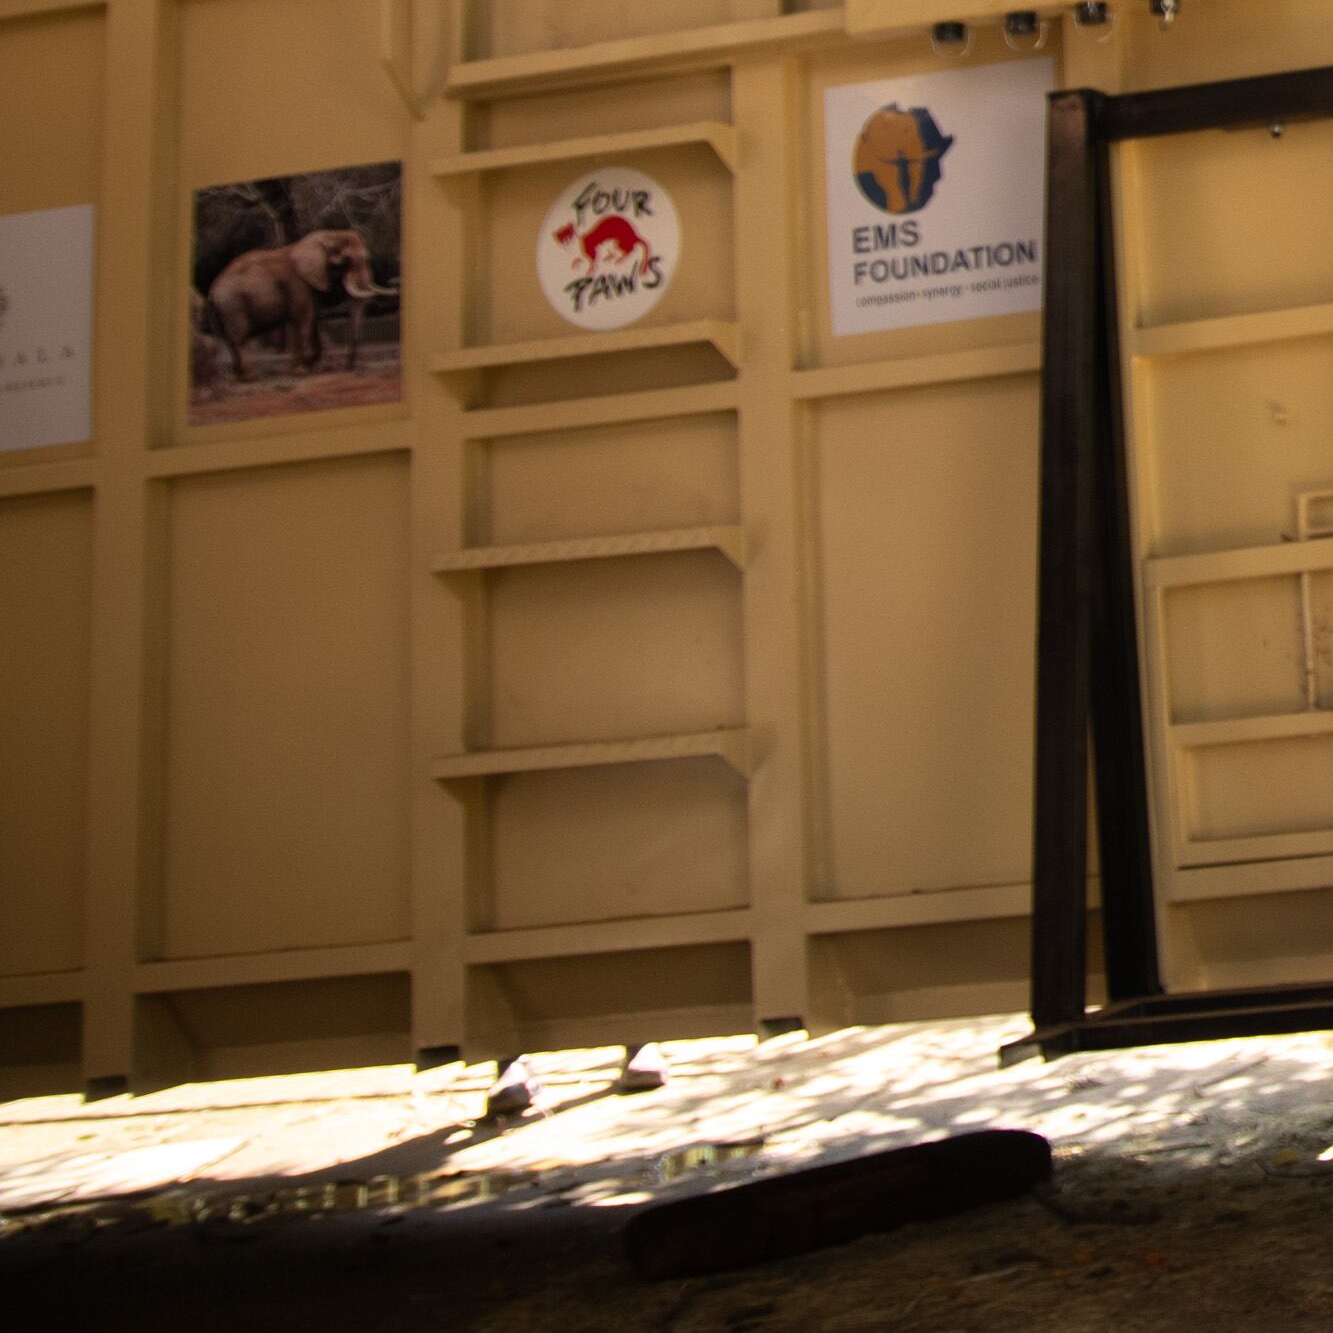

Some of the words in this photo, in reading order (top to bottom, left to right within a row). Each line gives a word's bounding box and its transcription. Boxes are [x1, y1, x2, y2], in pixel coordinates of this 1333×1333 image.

[572, 182, 654, 227] FOUR
[853, 220, 919, 254] EMS
[564, 256, 663, 312] PAWS
[853, 240, 1036, 286] FOUNDATION
